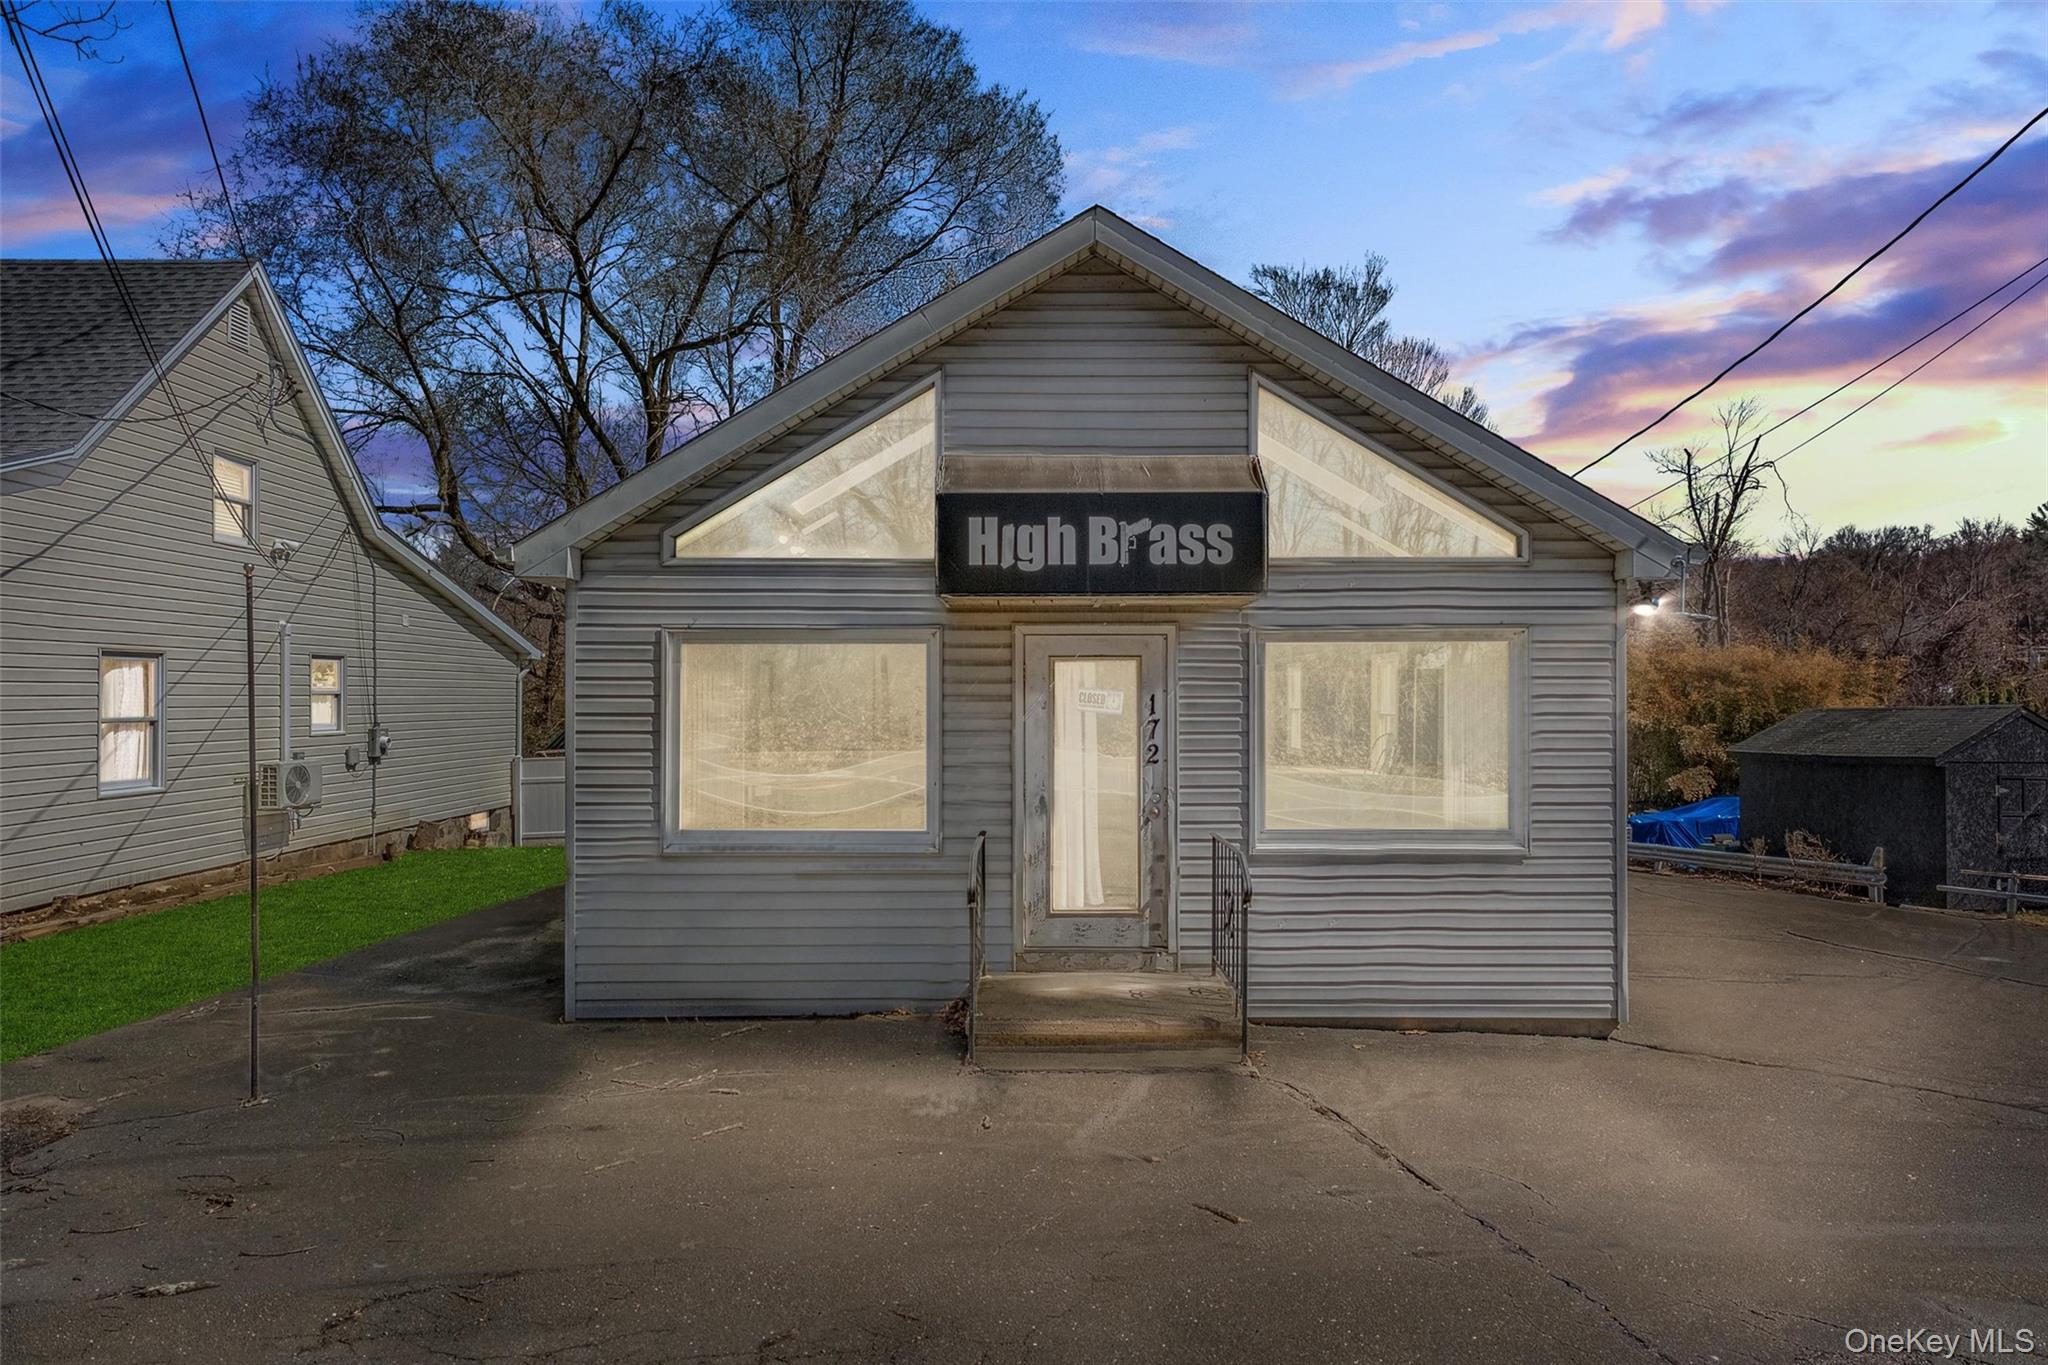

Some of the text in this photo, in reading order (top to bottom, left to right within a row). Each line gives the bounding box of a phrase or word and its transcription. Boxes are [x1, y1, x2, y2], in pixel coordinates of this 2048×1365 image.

[969, 516, 1234, 572] High Brass
[1078, 691, 1106, 705] CLOSED
[1146, 693, 1161, 765] 172
